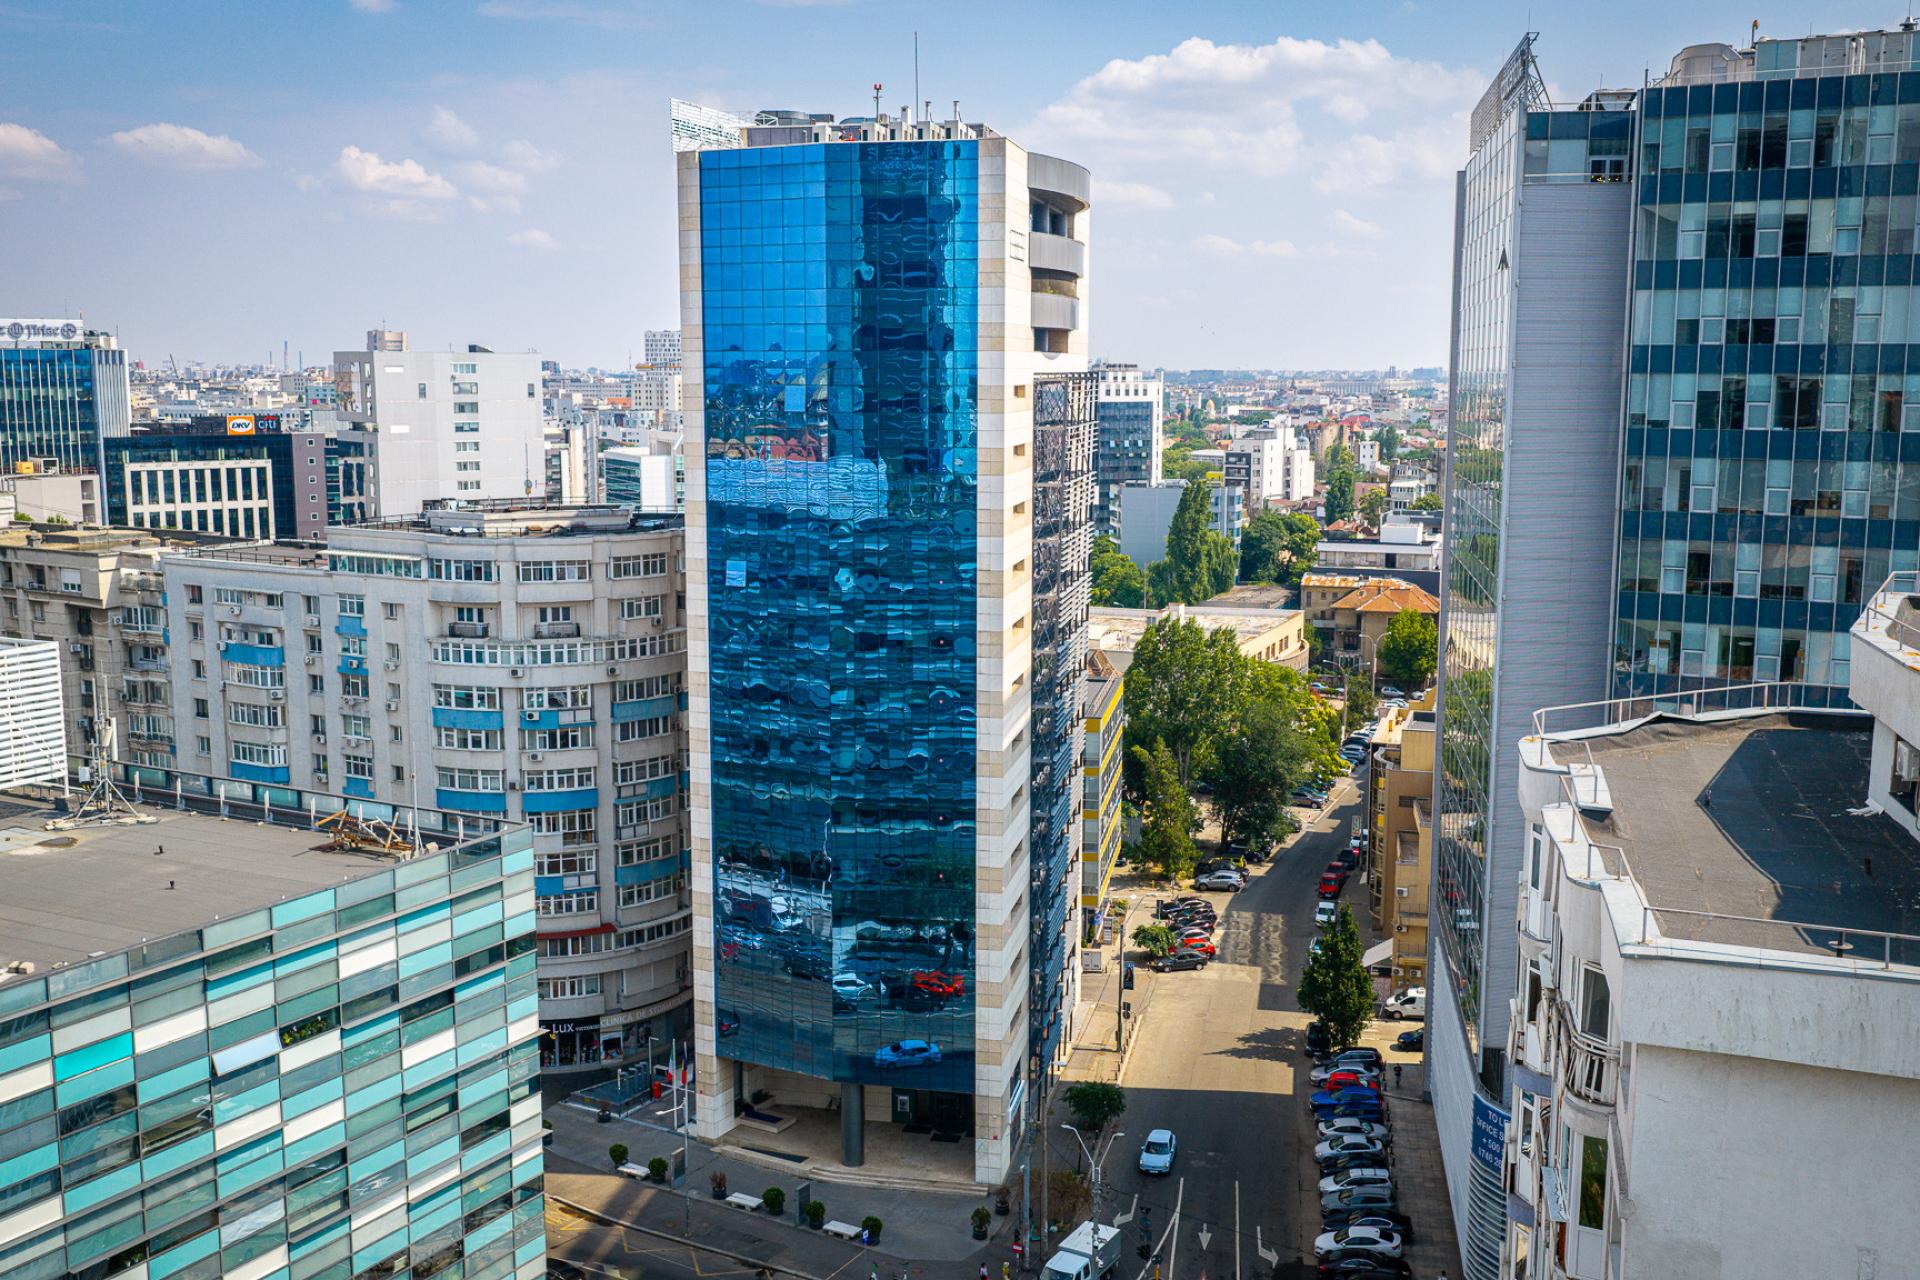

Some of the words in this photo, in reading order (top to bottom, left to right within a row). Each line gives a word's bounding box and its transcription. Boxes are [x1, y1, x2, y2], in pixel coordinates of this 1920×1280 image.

[231, 421, 251, 429] DKV
[552, 1023, 575, 1034] LUX
[1487, 1110, 1498, 1124] TO
